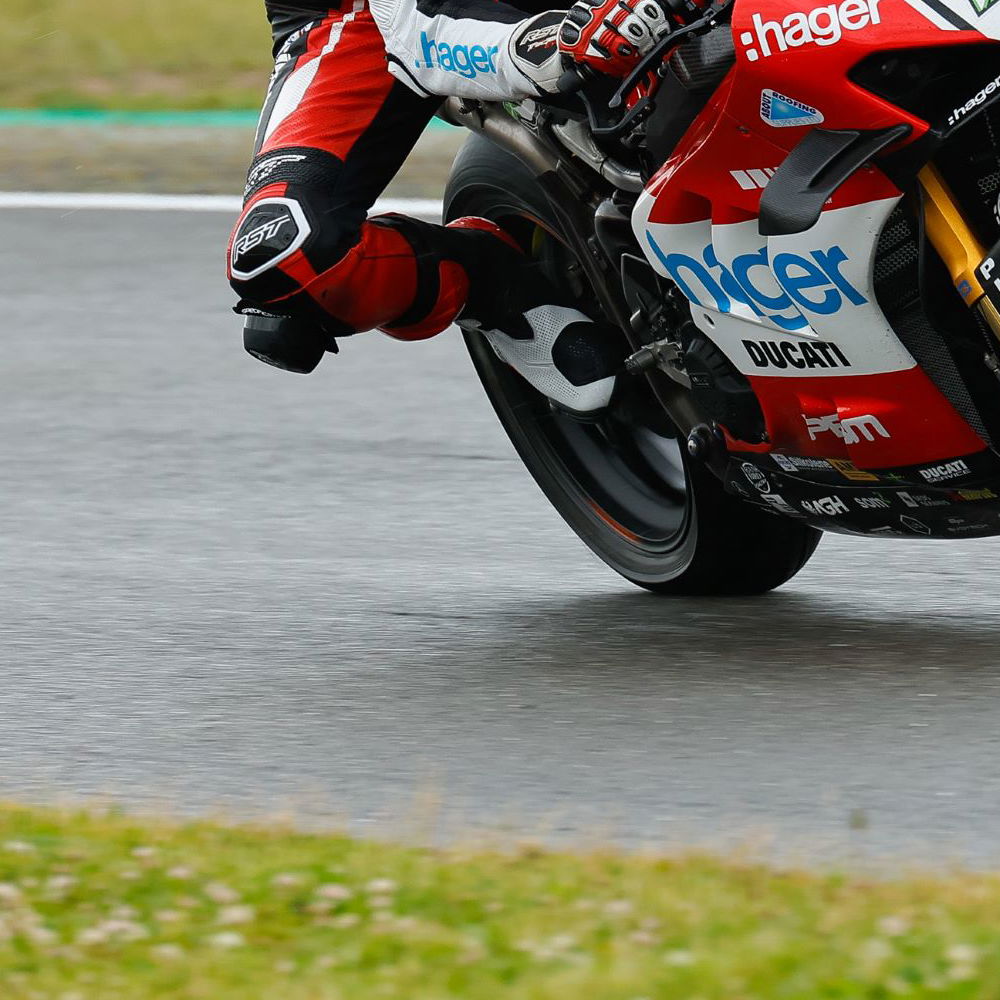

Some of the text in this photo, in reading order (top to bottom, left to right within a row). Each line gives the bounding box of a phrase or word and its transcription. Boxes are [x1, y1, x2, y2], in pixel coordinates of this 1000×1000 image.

[761, 91, 817, 119] ABOUT ROOFING
[234, 214, 291, 265] RST
[741, 339, 851, 369] DUCATI
[918, 459, 969, 479] DUCATI
